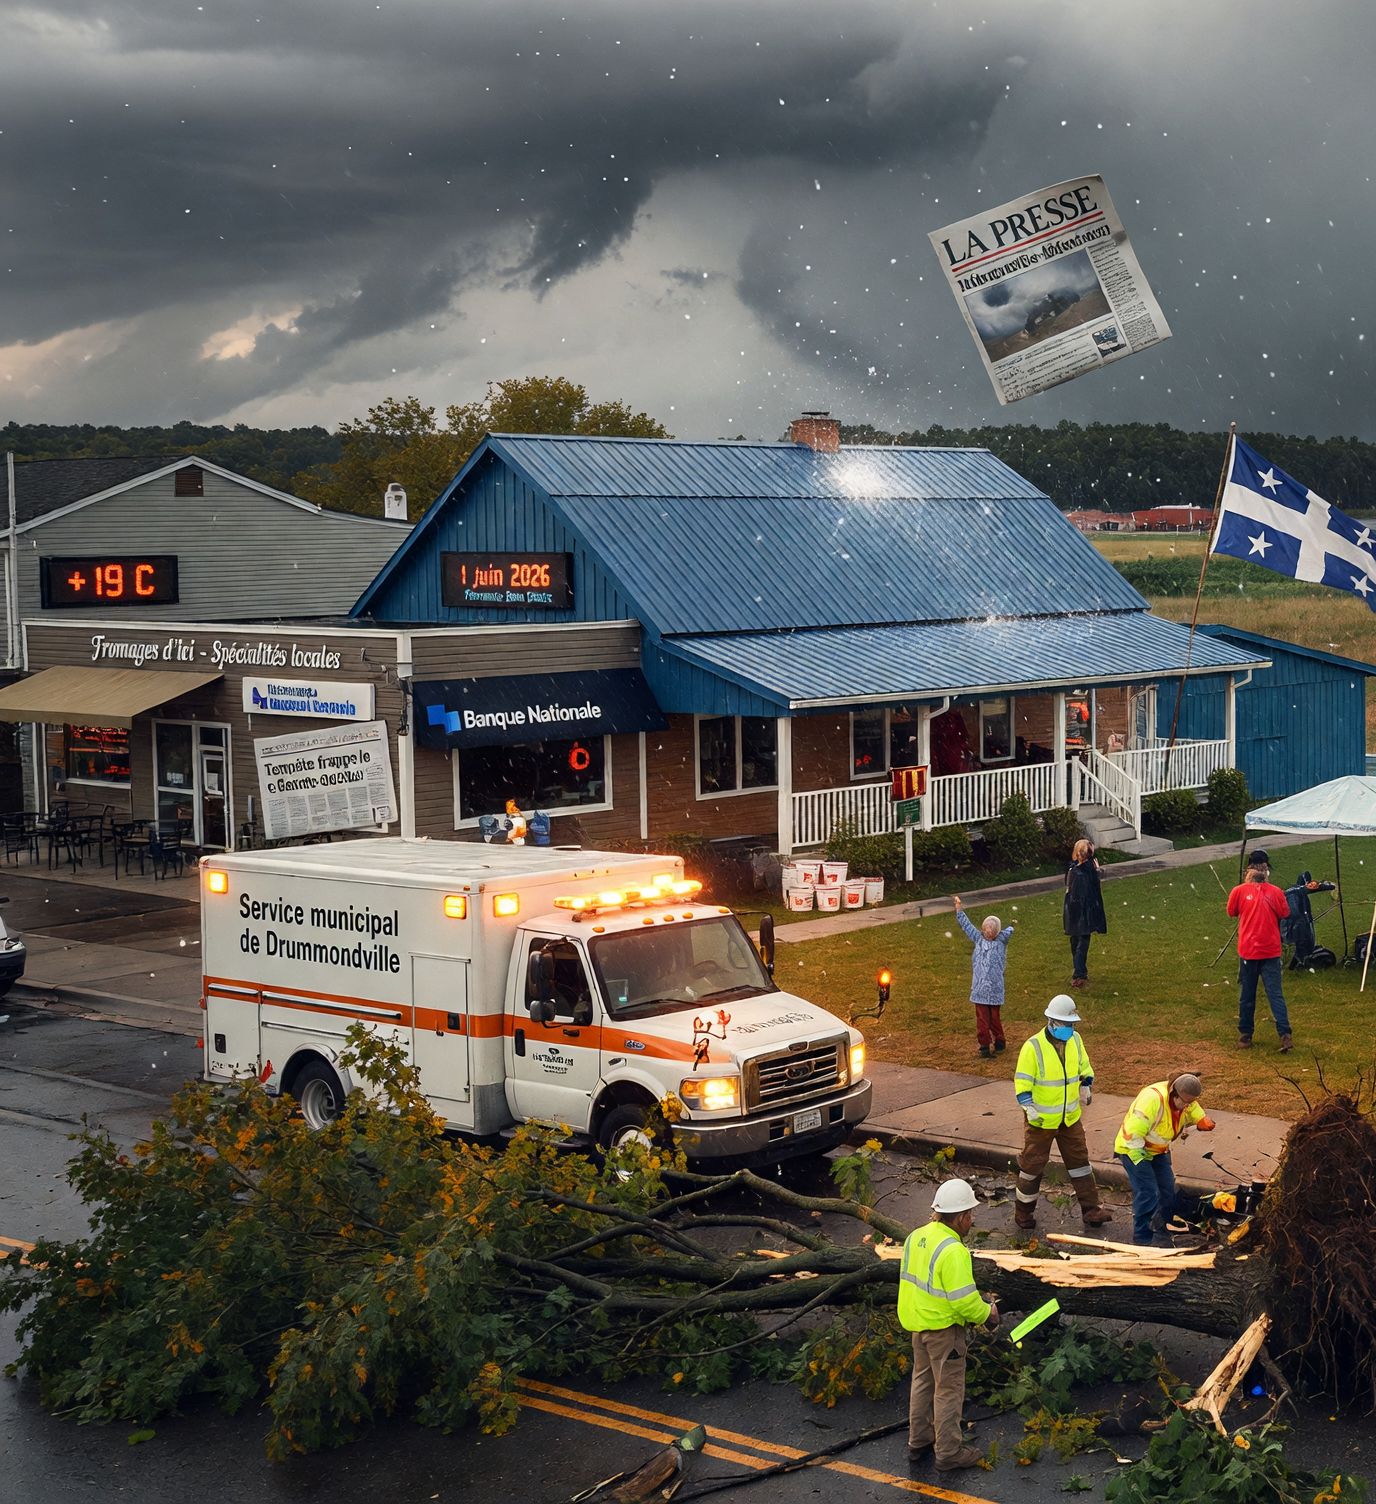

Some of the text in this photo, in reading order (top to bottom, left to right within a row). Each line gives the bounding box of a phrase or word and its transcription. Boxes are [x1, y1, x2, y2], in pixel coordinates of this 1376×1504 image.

[942, 230, 991, 266] LA
[988, 185, 1098, 248] PRESSE
[135, 564, 155, 596] C
[472, 563, 503, 590] juin
[510, 563, 550, 588] 2026
[91, 634, 159, 667] Fromages
[291, 643, 340, 669] locales
[463, 701, 602, 731] Banque Nationale
[239, 892, 399, 940] Service municipal
[240, 927, 401, 974] de Drummondville
